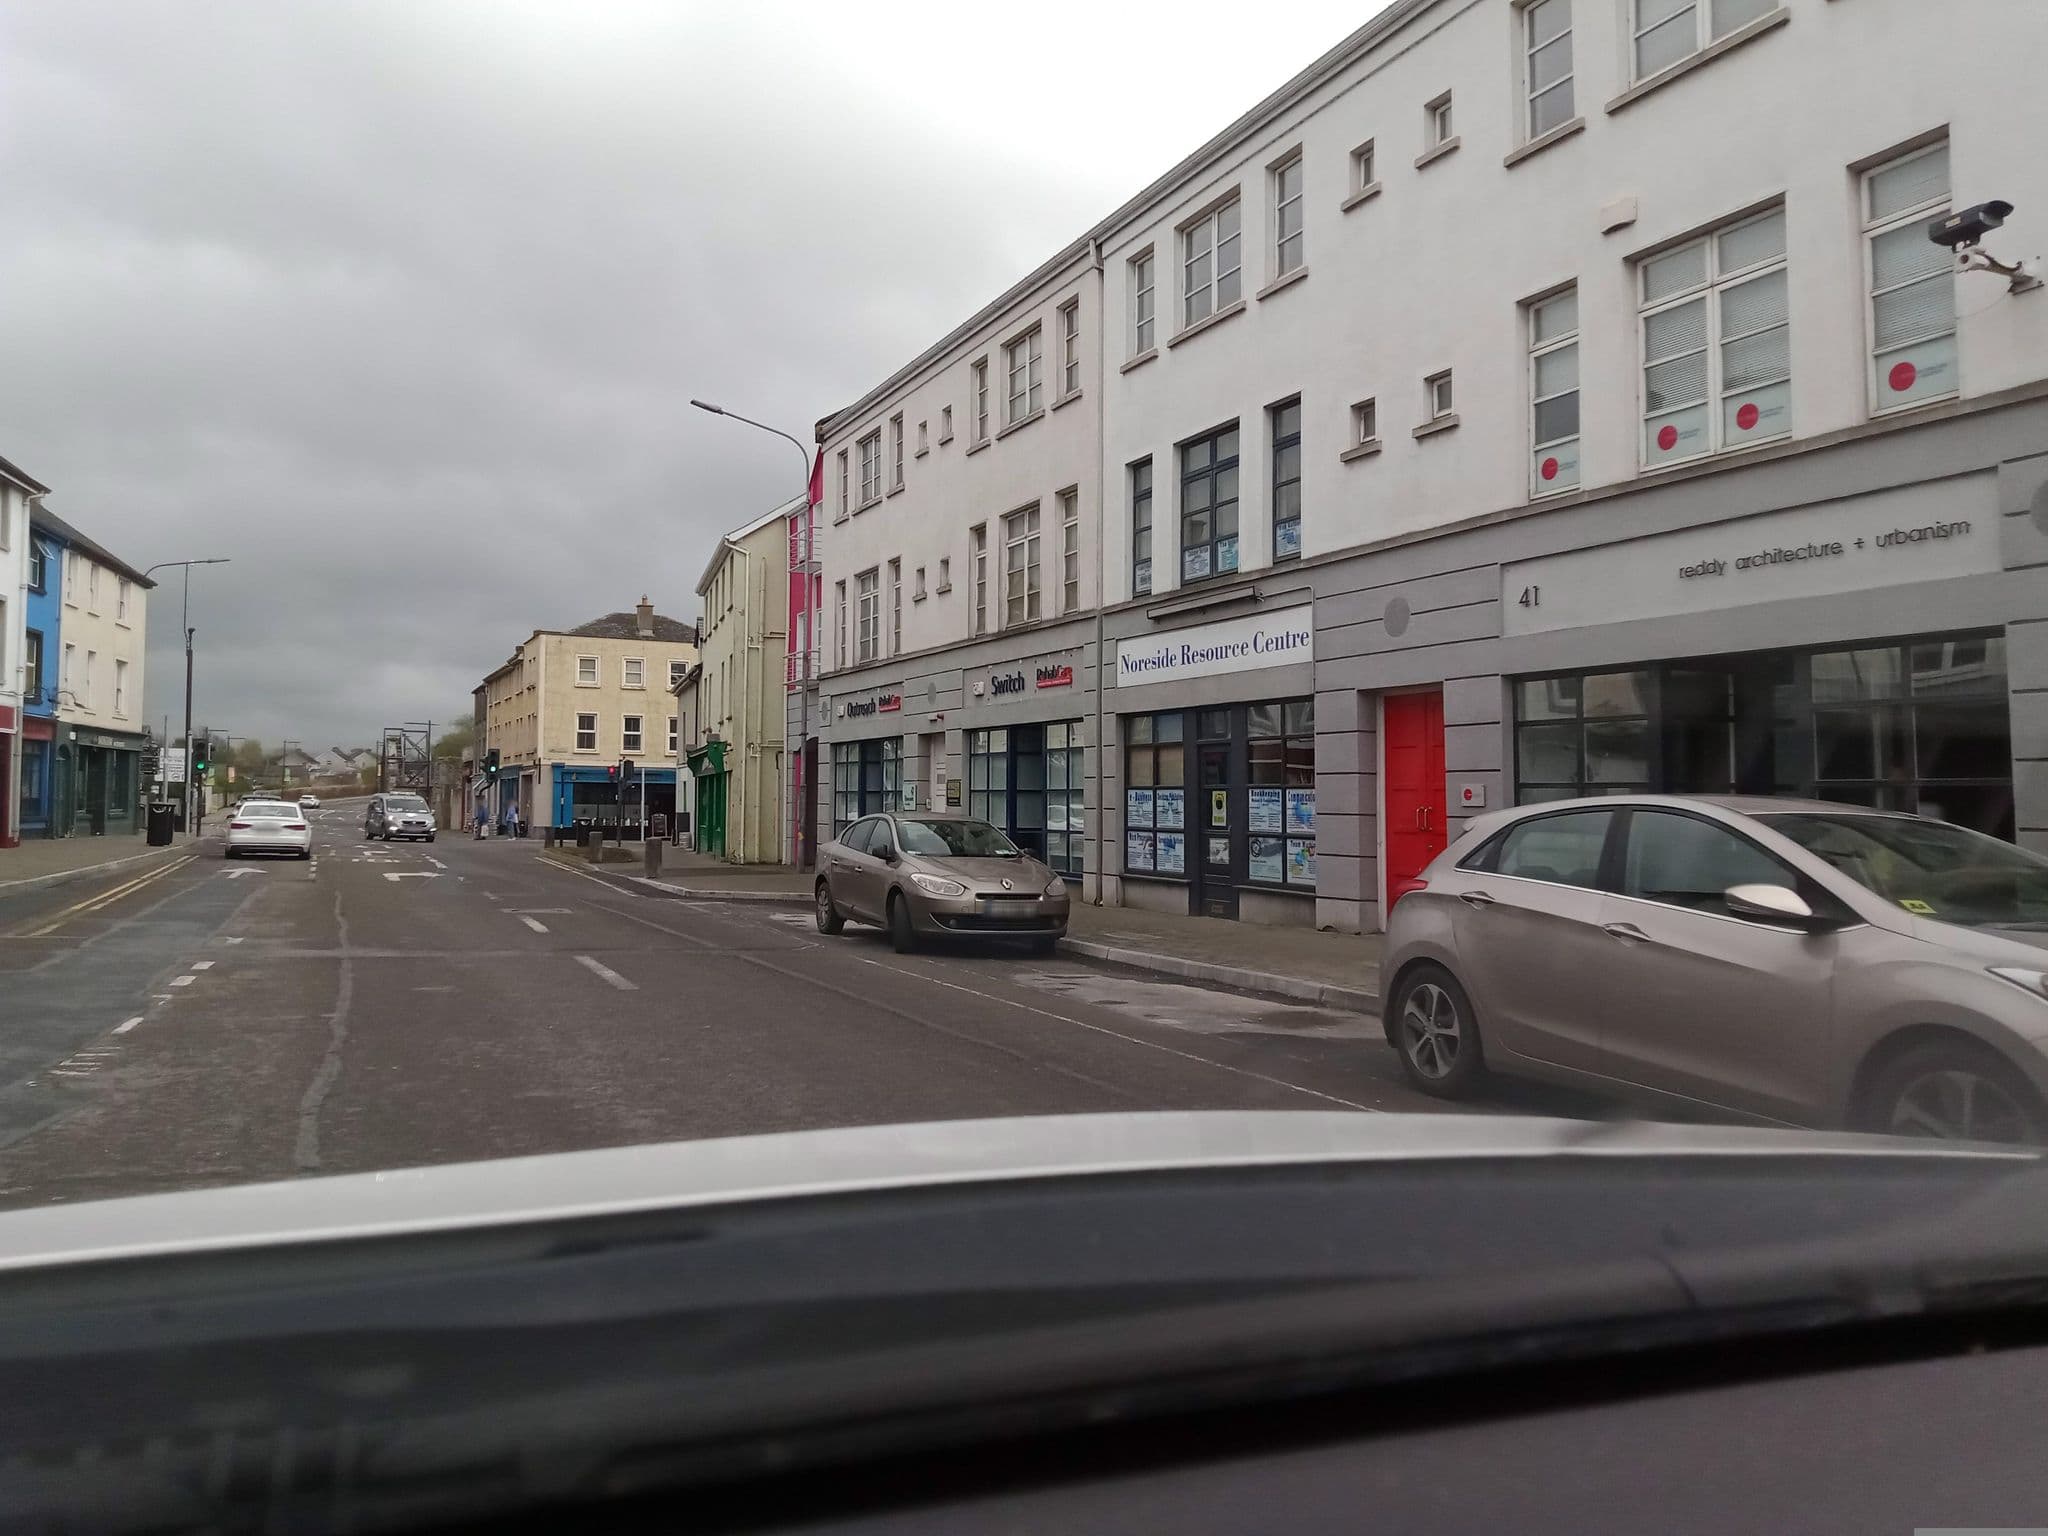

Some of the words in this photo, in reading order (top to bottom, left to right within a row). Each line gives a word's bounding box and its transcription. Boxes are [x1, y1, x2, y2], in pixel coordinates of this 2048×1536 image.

[1679, 559, 1727, 579] reddy
[1735, 541, 1843, 570] architecture
[1875, 520, 1971, 548] urbanism
[1518, 585, 1540, 608] 41
[1120, 648, 1177, 674] Noreside
[1180, 641, 1249, 666] Resource
[1253, 630, 1310, 654] Centre
[991, 670, 1025, 696] Switch
